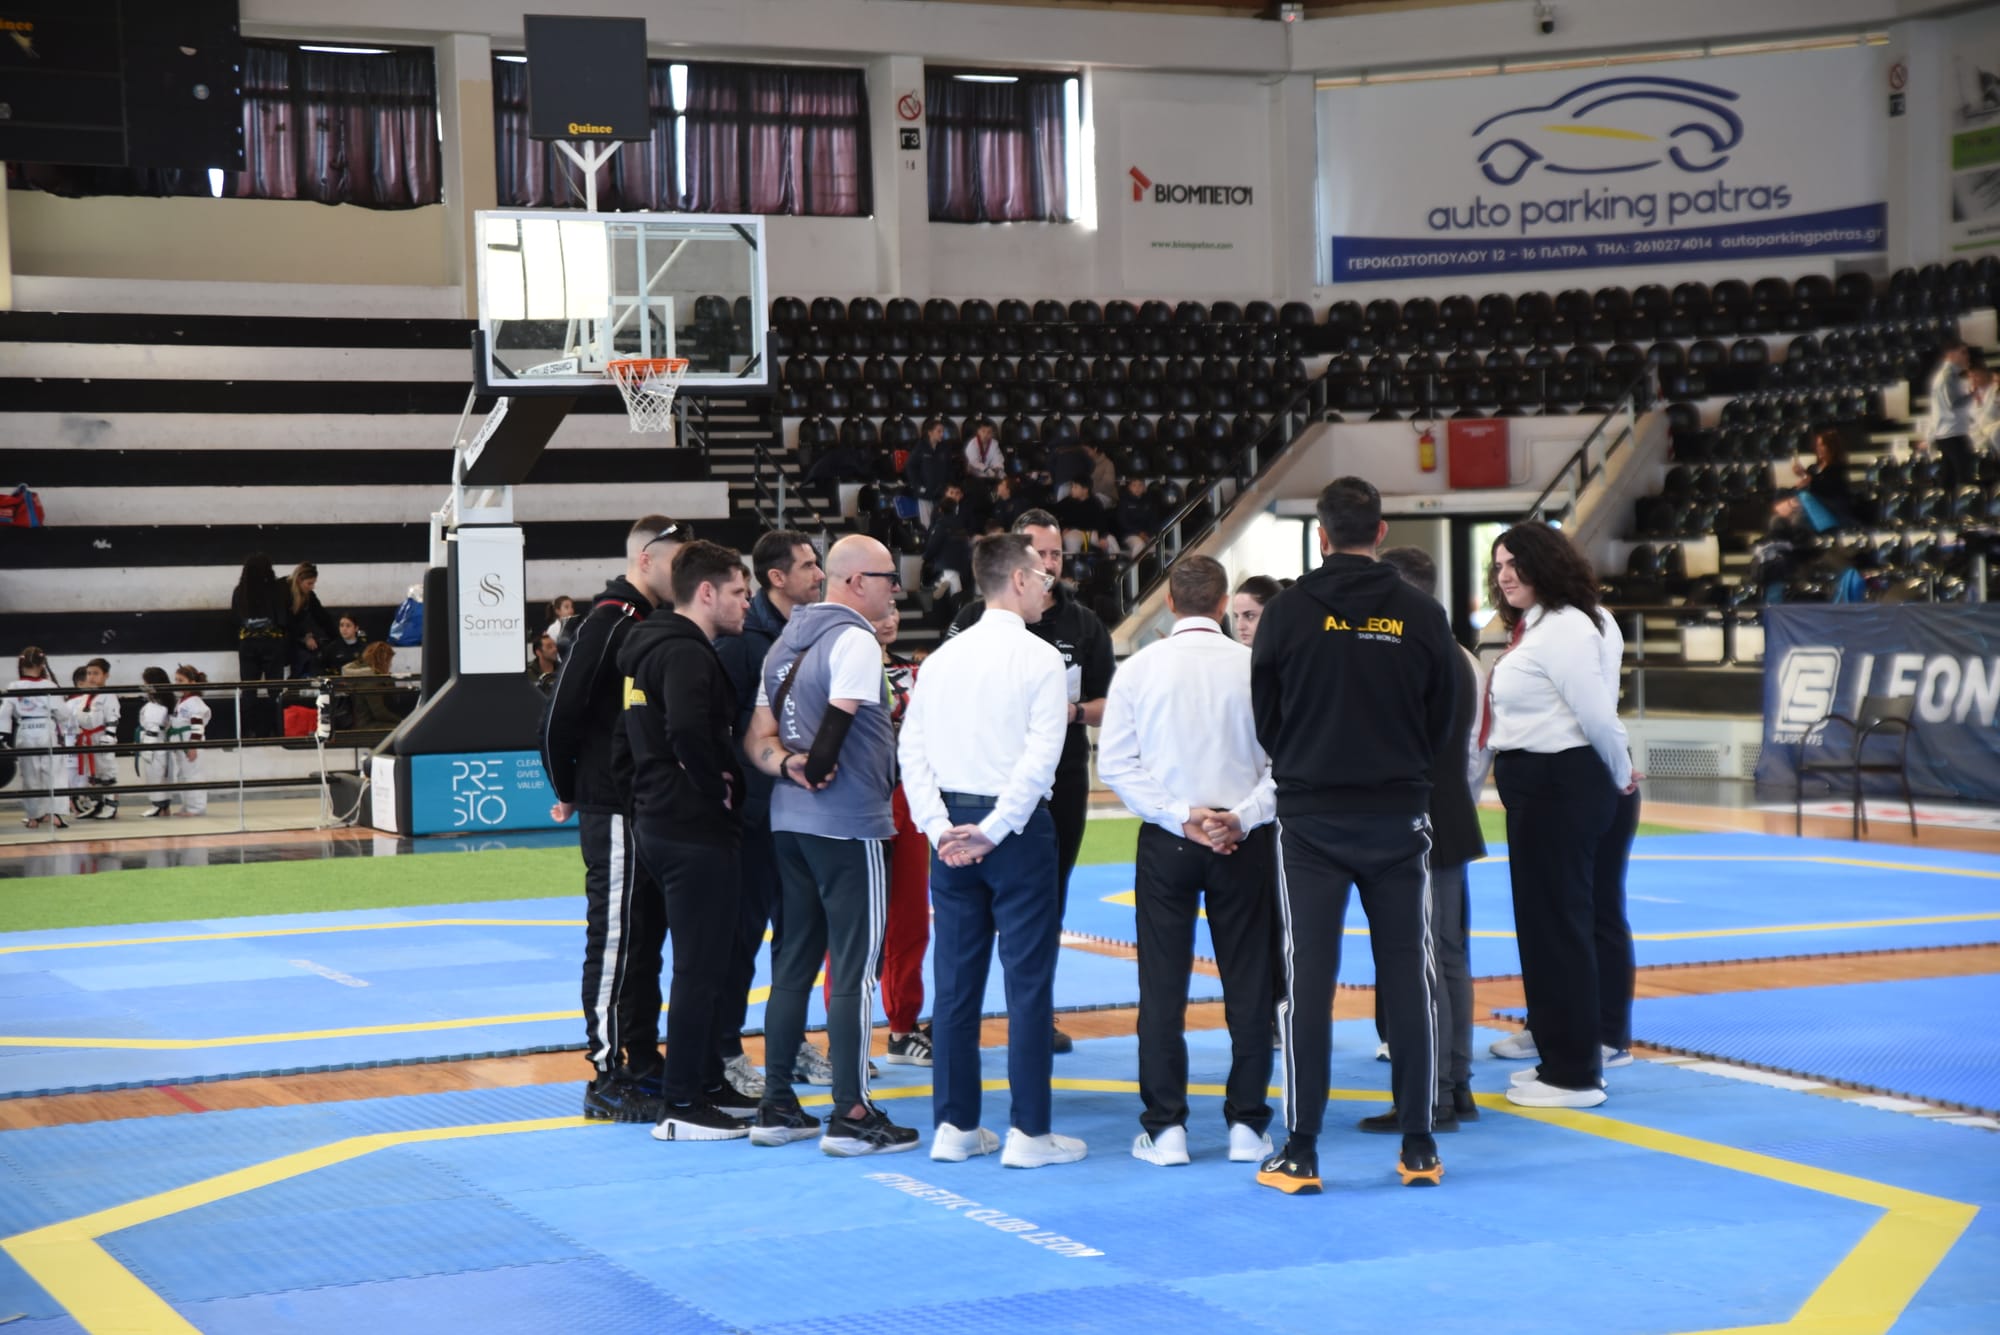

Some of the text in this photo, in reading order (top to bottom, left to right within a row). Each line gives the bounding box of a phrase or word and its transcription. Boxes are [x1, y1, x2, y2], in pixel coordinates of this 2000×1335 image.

[568, 122, 613, 135] Quince
[1428, 179, 1792, 235] auto parking patras
[1492, 249, 1505, 262] 12
[1523, 247, 1537, 260] 16
[1541, 245, 1588, 259] ΠΑΤΡΑ
[1634, 236, 1713, 254] 2610274014
[1721, 226, 1884, 250] autoparkingpatras.gr
[464, 614, 520, 631] Samar
[516, 770, 540, 778] GIVES
[517, 781, 544, 790] VALUE!
[963, 1209, 1040, 1233] CLUB
[1017, 1231, 1106, 1258] LEON
